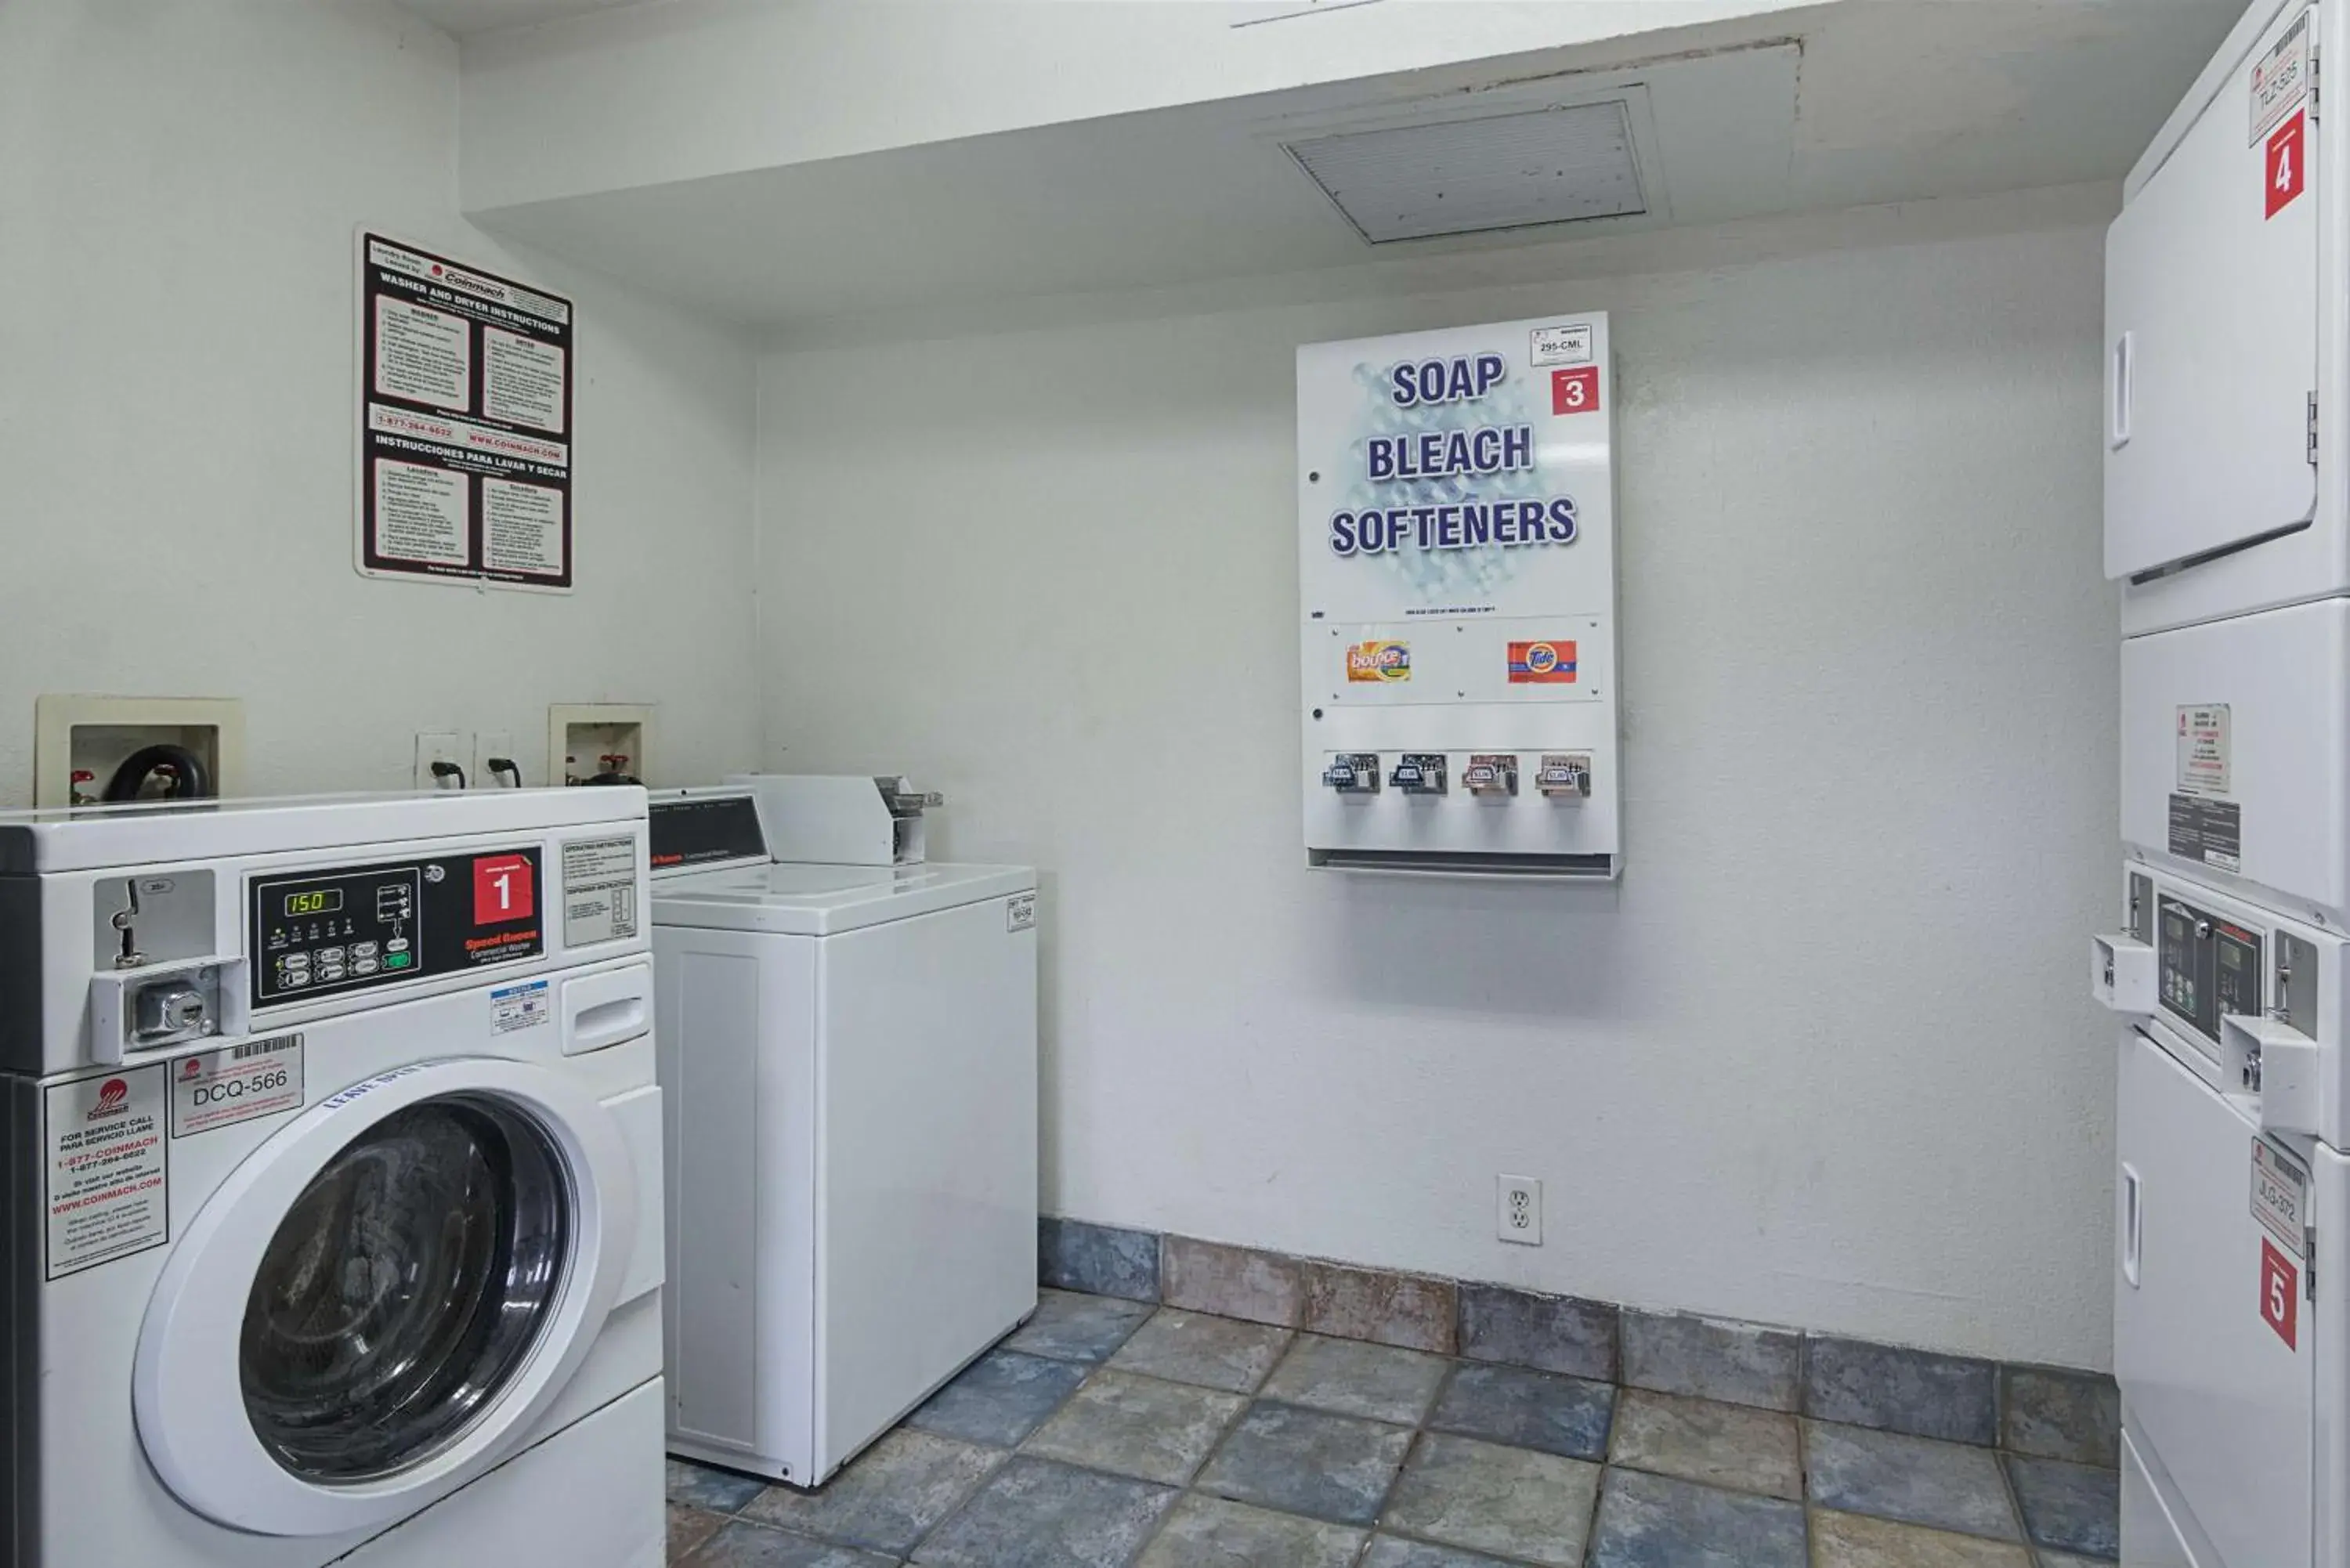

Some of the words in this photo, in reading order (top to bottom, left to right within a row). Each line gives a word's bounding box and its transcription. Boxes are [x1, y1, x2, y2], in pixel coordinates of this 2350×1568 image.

[2276, 145, 2291, 193] 4
[380, 272, 427, 294] WASHER
[429, 287, 452, 301] AND
[455, 295, 489, 312] DRYER
[490, 305, 560, 334] INSTRUCTIONS
[445, 273, 505, 298] Coinmach
[1393, 355, 1503, 404] SOAP
[1566, 380, 1585, 406] 3
[376, 435, 464, 459] INSTRUCCIONES
[466, 452, 493, 464] PARA
[495, 457, 526, 471] LAVAR
[528, 464, 535, 472] Y
[537, 465, 567, 479] SECAR
[1368, 425, 1531, 479] BLEACH
[1332, 498, 1575, 553] SOFTENERS
[1530, 651, 1555, 667] Tide
[292, 894, 322, 912] 150
[493, 874, 509, 909] 1
[193, 1070, 287, 1107] DCQ-566
[60, 1132, 82, 1143] FOR
[84, 1121, 126, 1138] SERVICE
[129, 1115, 154, 1126] CALL
[60, 1140, 84, 1152] PARA
[85, 1131, 125, 1145] SERVICIO
[126, 1122, 154, 1136] LLAME
[58, 1134, 158, 1169] 1-877-COINMACH
[52, 1177, 162, 1215] WWW.COINMACH.COM
[2271, 1271, 2284, 1322] 5
